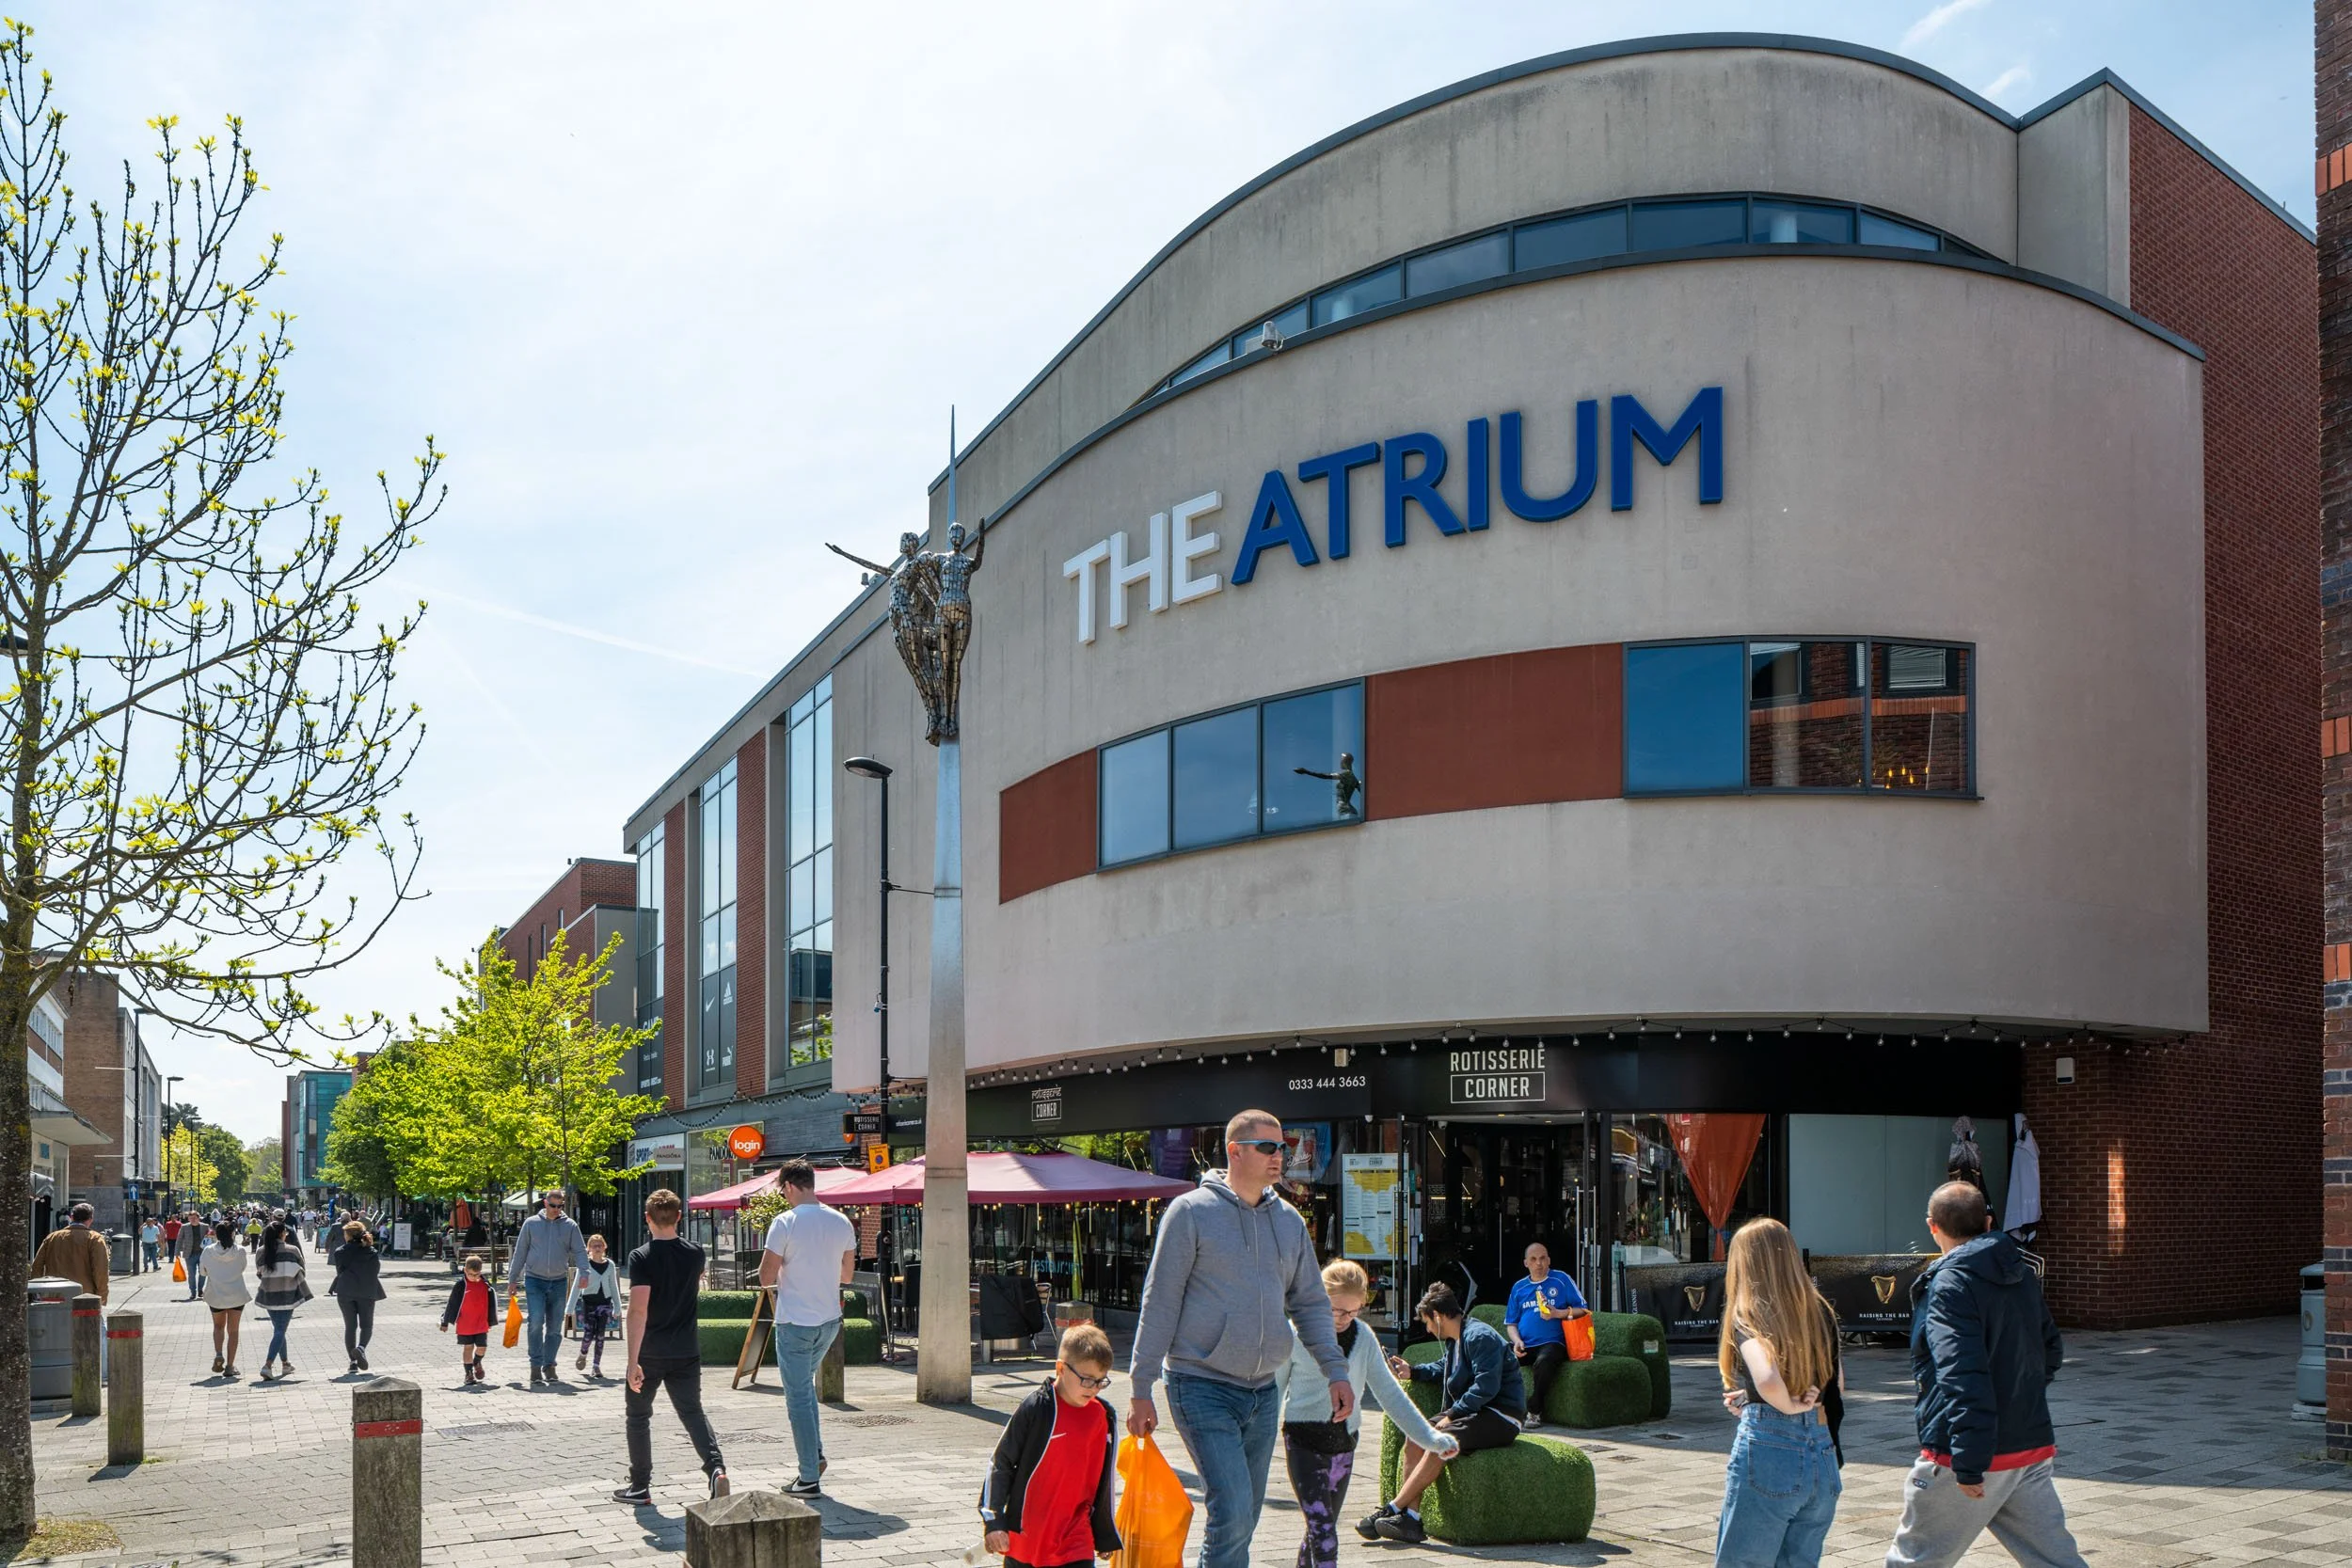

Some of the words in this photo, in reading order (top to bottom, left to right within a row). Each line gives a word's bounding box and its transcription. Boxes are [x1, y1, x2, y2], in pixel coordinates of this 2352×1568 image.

[1063, 490, 1222, 645] THE
[1231, 386, 1724, 586] ATRIUM
[1450, 1048, 1546, 1072] ROTISSERIE
[1288, 1078, 1313, 1090] 0333
[1316, 1077, 1335, 1088] 444
[1339, 1075, 1366, 1087] 3663
[1465, 1076, 1530, 1099] CORNER
[1036, 1102, 1057, 1117] CORNER
[734, 1139, 761, 1152] login
